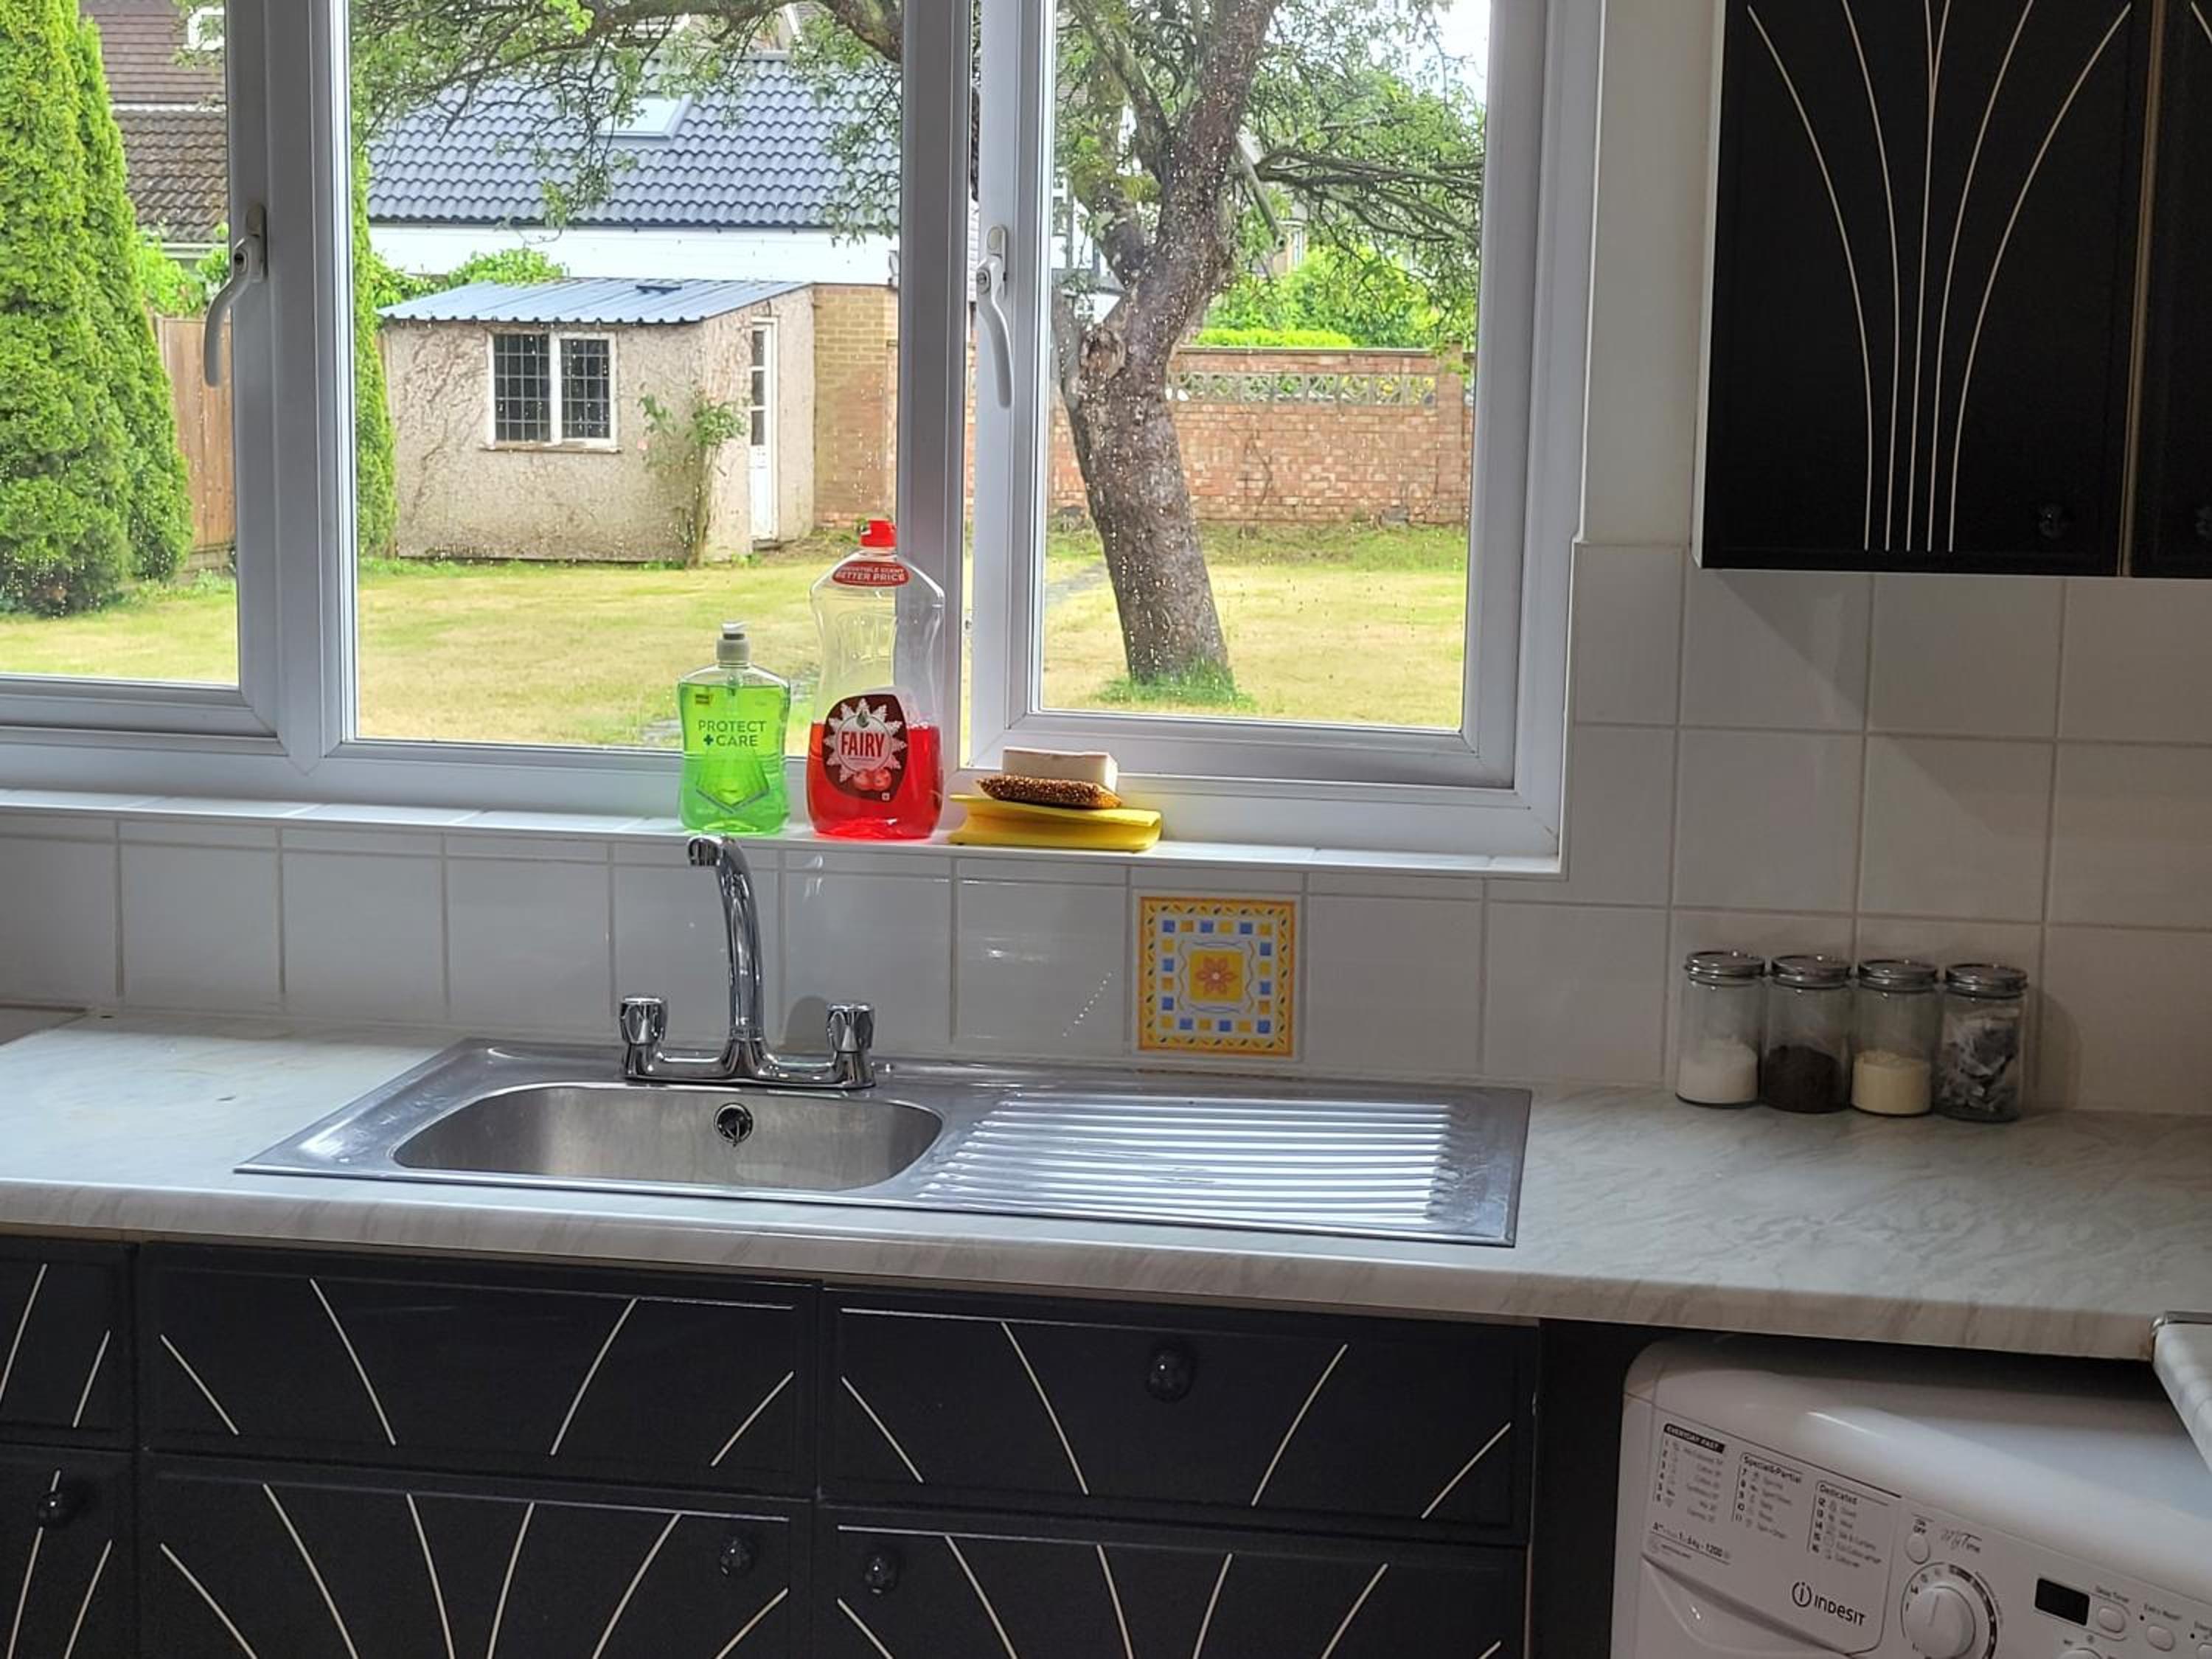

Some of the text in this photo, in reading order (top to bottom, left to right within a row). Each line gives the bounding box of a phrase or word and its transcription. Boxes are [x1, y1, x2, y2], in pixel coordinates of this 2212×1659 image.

[872, 572, 905, 582] PRICE
[698, 720, 767, 732] PROTECT
[716, 734, 758, 747] CARE
[841, 731, 885, 757] FAIRY
[1700, 1438, 1719, 1451] FAST
